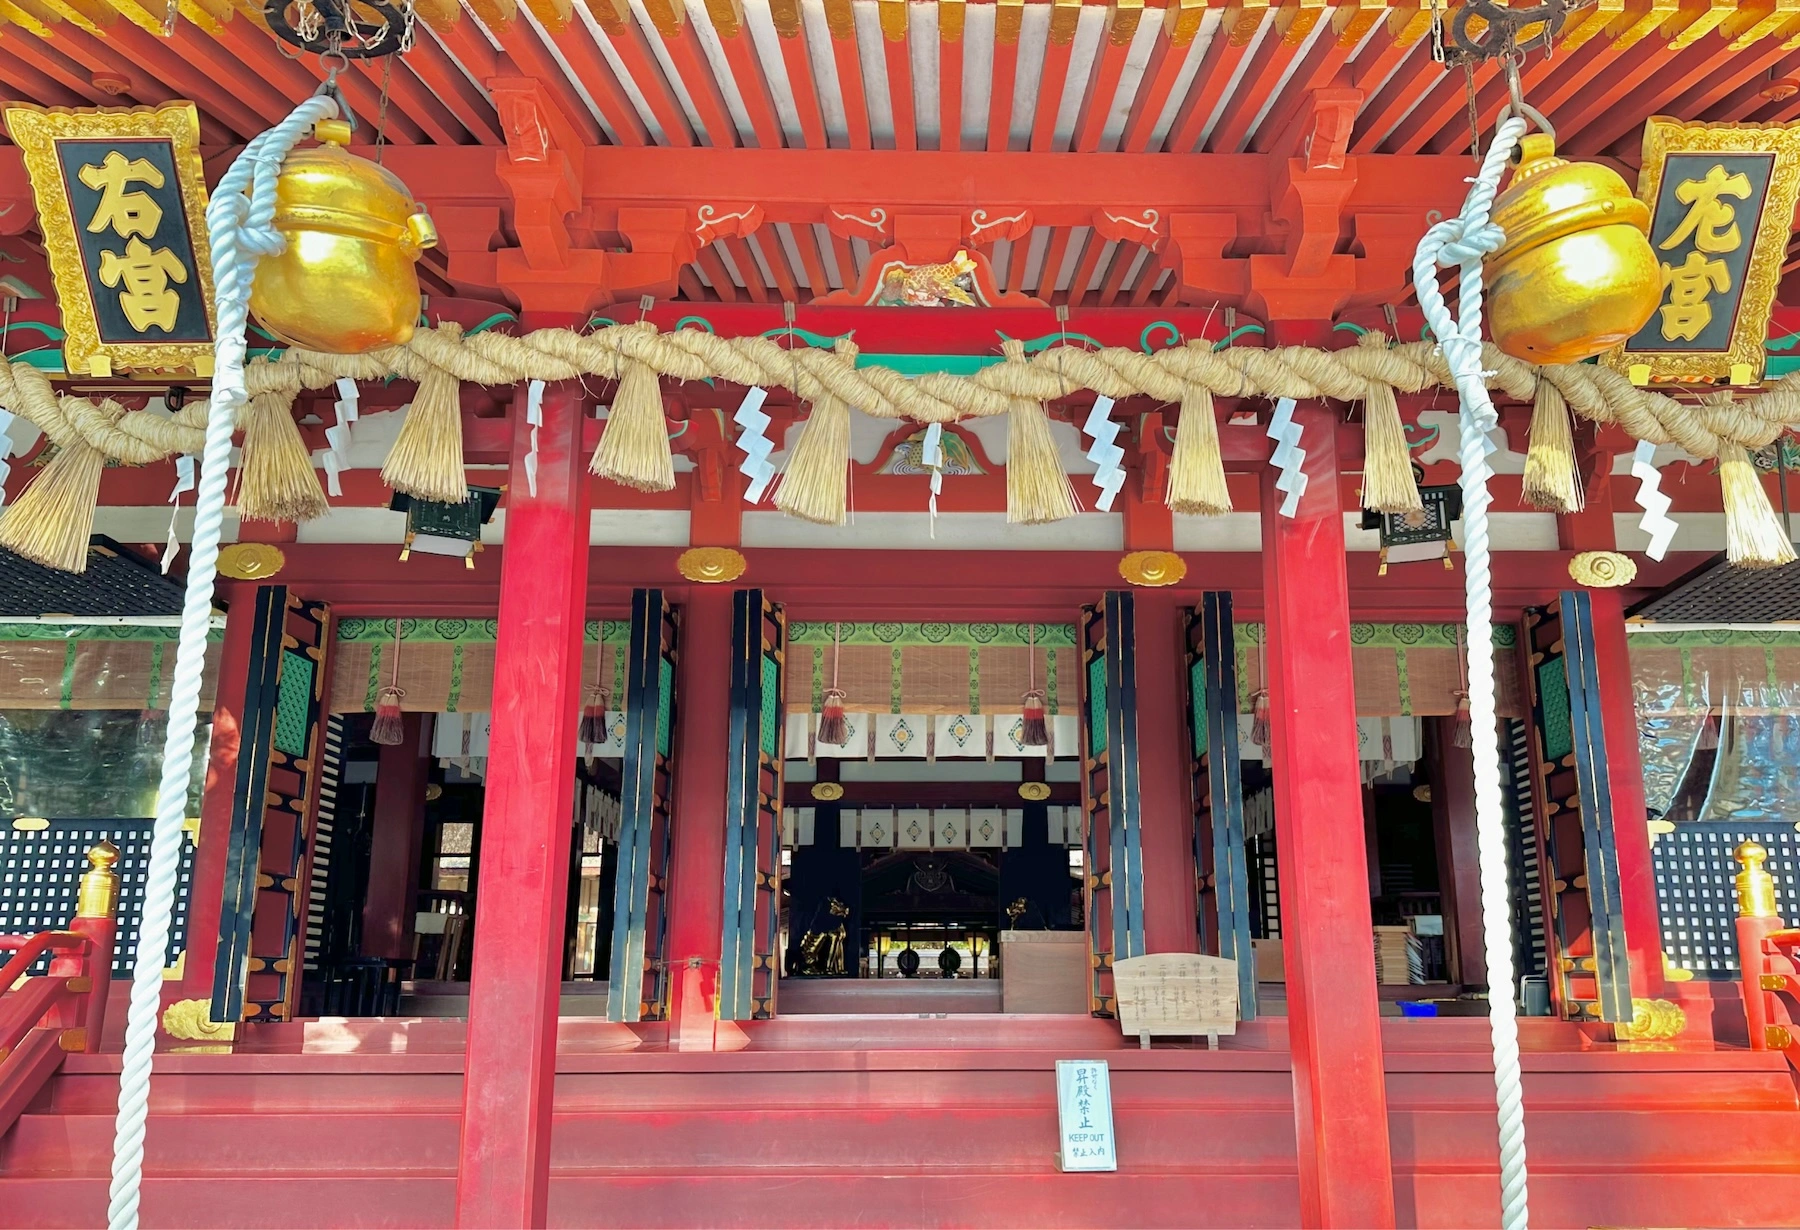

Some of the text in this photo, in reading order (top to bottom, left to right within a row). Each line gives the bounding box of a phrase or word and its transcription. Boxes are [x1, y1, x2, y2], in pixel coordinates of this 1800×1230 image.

[78, 150, 188, 333] 右宮
[1075, 1068, 1093, 1129] 昇殿禁止
[1068, 1133, 1104, 1142] KEEP OUT
